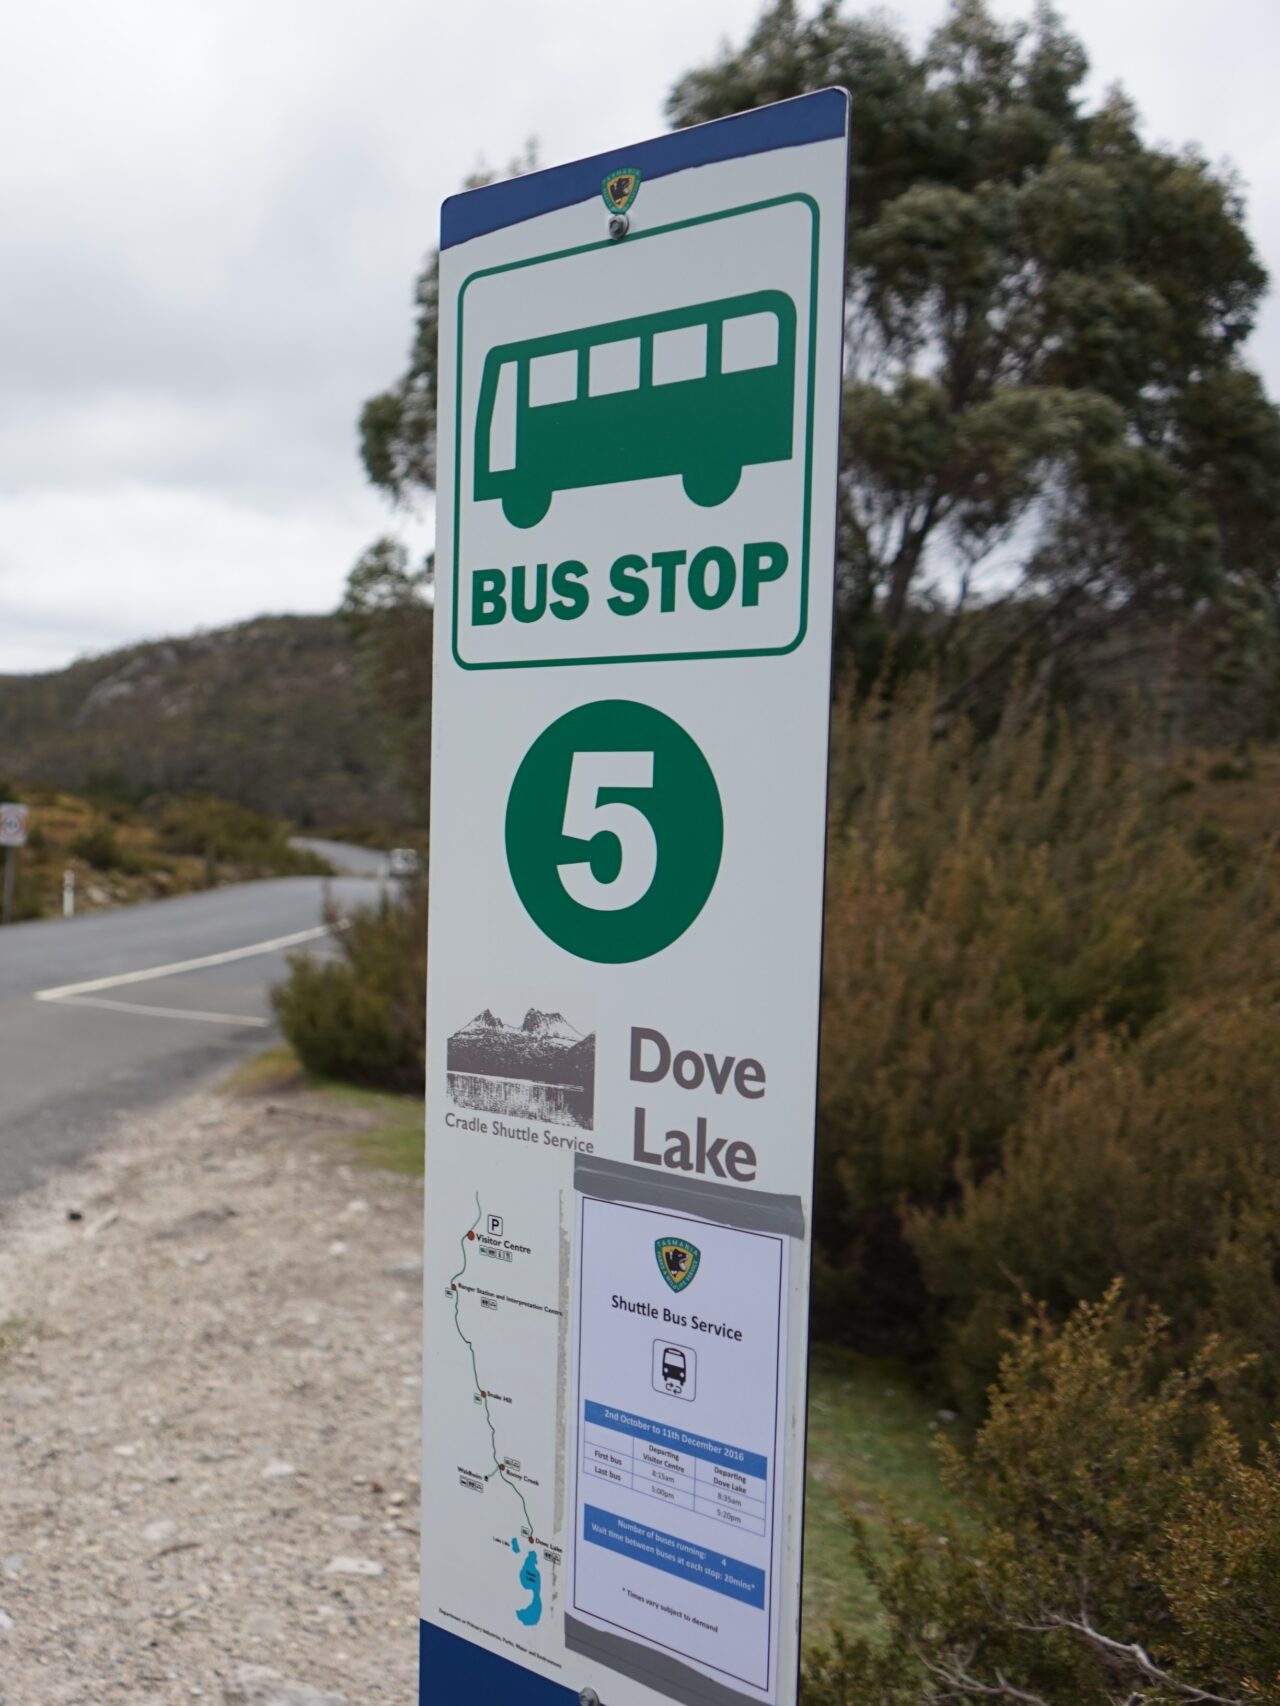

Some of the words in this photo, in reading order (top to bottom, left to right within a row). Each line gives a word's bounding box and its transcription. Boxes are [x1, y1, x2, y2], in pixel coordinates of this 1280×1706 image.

[471, 560, 589, 626] BUS
[607, 541, 789, 616] STOP
[556, 751, 657, 911] 5
[629, 1026, 766, 1099] Dove
[445, 1113, 488, 1134] Cradle
[492, 1119, 539, 1144] Shuttle
[543, 1129, 594, 1153] Service
[633, 1106, 757, 1182] Lake
[476, 1233, 502, 1247] Visitor
[503, 1240, 531, 1254] Centre
[491, 1218, 500, 1231] P
[611, 1294, 659, 1319] Shuttle
[663, 1308, 687, 1327] Bus
[691, 1315, 743, 1342] Service
[604, 1409, 619, 1421] 2nd
[620, 1414, 650, 1431] October
[652, 1425, 661, 1434] to
[662, 1428, 679, 1440] 11th
[681, 1434, 721, 1454] December
[724, 1447, 744, 1462] 2016
[649, 1444, 679, 1461] Departing
[594, 1449, 609, 1460] First
[610, 1455, 622, 1465] bus
[594, 1465, 608, 1477] Last
[609, 1471, 621, 1481] bus
[643, 1453, 662, 1465] Visitor
[664, 1460, 685, 1473] Centre
[714, 1466, 747, 1485] Departing
[713, 1476, 730, 1488] Dove
[732, 1483, 747, 1494] Lake
[592, 1523, 607, 1536] Wait
[608, 1530, 624, 1542] time
[625, 1535, 655, 1554] between
[656, 1547, 676, 1562] buses
[677, 1557, 685, 1566] at
[686, 1560, 703, 1573] each
[704, 1567, 723, 1580] stop:
[618, 1519, 646, 1536] Number
[646, 1530, 655, 1539] of
[655, 1534, 675, 1548] buses
[676, 1543, 707, 1560] running:
[721, 1558, 727, 1567] 4
[627, 1589, 645, 1602] Times
[646, 1598, 659, 1609] vary
[660, 1604, 682, 1618] subject
[684, 1613, 691, 1622] to
[691, 1617, 718, 1633] demand
